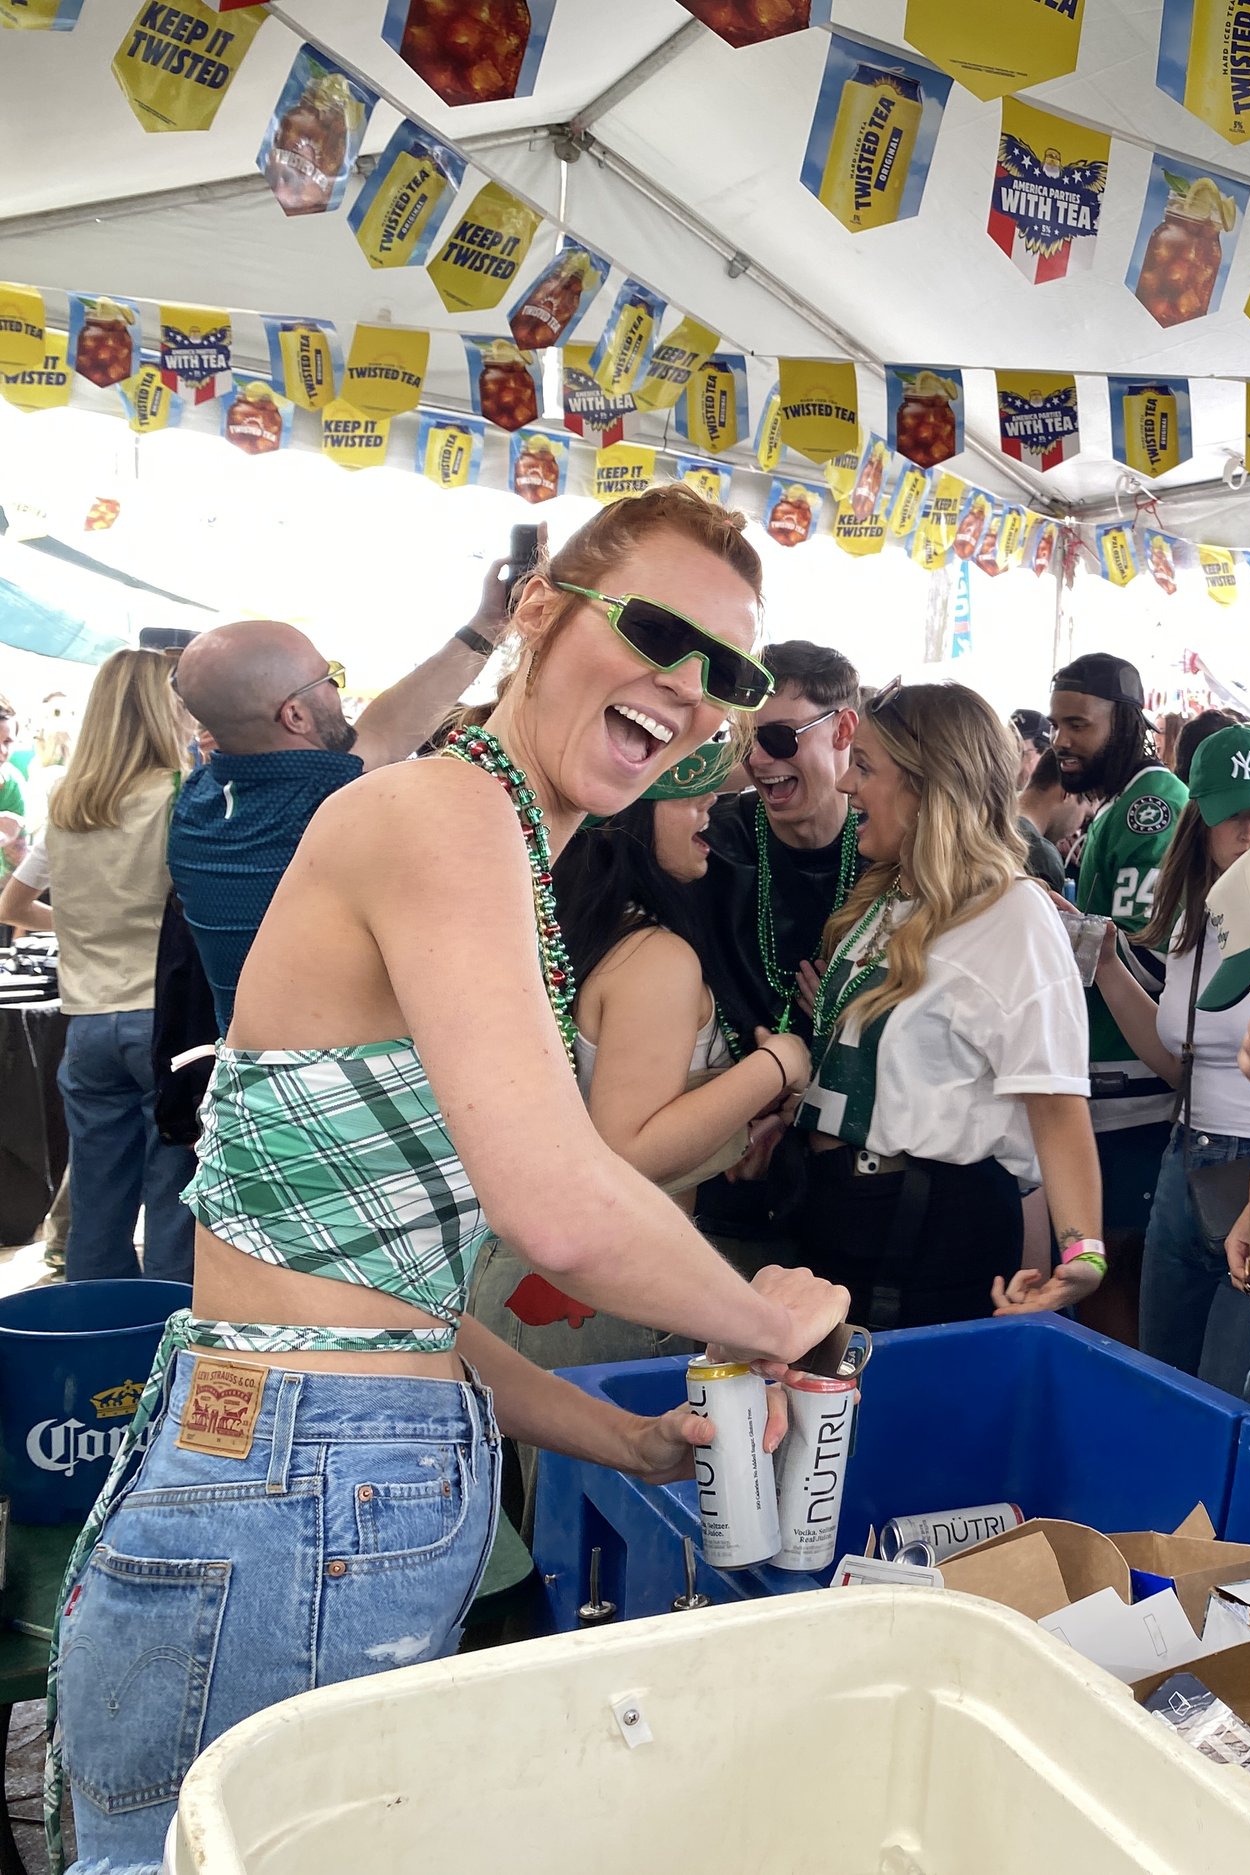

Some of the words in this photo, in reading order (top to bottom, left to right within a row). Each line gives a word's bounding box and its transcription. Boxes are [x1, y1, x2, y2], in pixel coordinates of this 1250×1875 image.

[1227, 0, 1235, 17] TEA
[139, 1, 210, 45] KEEP
[205, 27, 235, 57] IT
[127, 30, 231, 91] TWISTED
[855, 131, 879, 210] TWISTED
[868, 96, 895, 130] TEA
[879, 137, 899, 181] ORIGINAL
[1012, 179, 1048, 195] AMERICA
[1049, 188, 1081, 204] PARTIES
[380, 191, 412, 253] TWISTED
[405, 167, 430, 198] TEA
[401, 199, 425, 235] ORIGINAL
[1000, 187, 1051, 220] WITH
[1056, 203, 1092, 230] TEA
[454, 221, 504, 251] KEEP
[502, 235, 520, 256] IT
[442, 242, 518, 280] TWISTED
[24, 324, 43, 340] TEA
[302, 335, 310, 352] TEA
[612, 337, 633, 385] TWISTED
[630, 315, 644, 336] TEA
[44, 356, 59, 369] IT
[165, 355, 199, 369] WITH
[200, 355, 227, 368] TEA
[652, 345, 683, 363] KEEP
[683, 352, 700, 366] IT
[301, 354, 318, 398] TWISTED
[348, 366, 399, 380] TWISTED
[400, 371, 421, 389] TEA
[706, 375, 717, 394] TEA
[568, 397, 605, 412] WITH
[609, 393, 634, 410] TEA
[1146, 398, 1158, 418] TEA
[705, 395, 720, 441] TWISTED
[782, 404, 833, 420] TWISTED
[834, 405, 856, 425] TEA
[324, 420, 361, 432] KEEP
[364, 420, 377, 432] IT
[1005, 418, 1044, 437] WITH
[1045, 416, 1073, 432] TEA
[324, 435, 383, 447] TWISTED
[1145, 418, 1161, 465] TWISTED
[443, 449, 451, 484] TWISTED
[597, 466, 627, 479] KEEP
[631, 465, 643, 478] IT
[836, 526, 883, 537] TWISTED
[1203, 563, 1221, 574] KEEP
[1206, 575, 1236, 587] TWISTED
[198, 1371, 210, 1380] LEVI
[210, 1371, 237, 1384] STRAUSS
[238, 1377, 243, 1386] &
[244, 1379, 255, 1388] CO.
